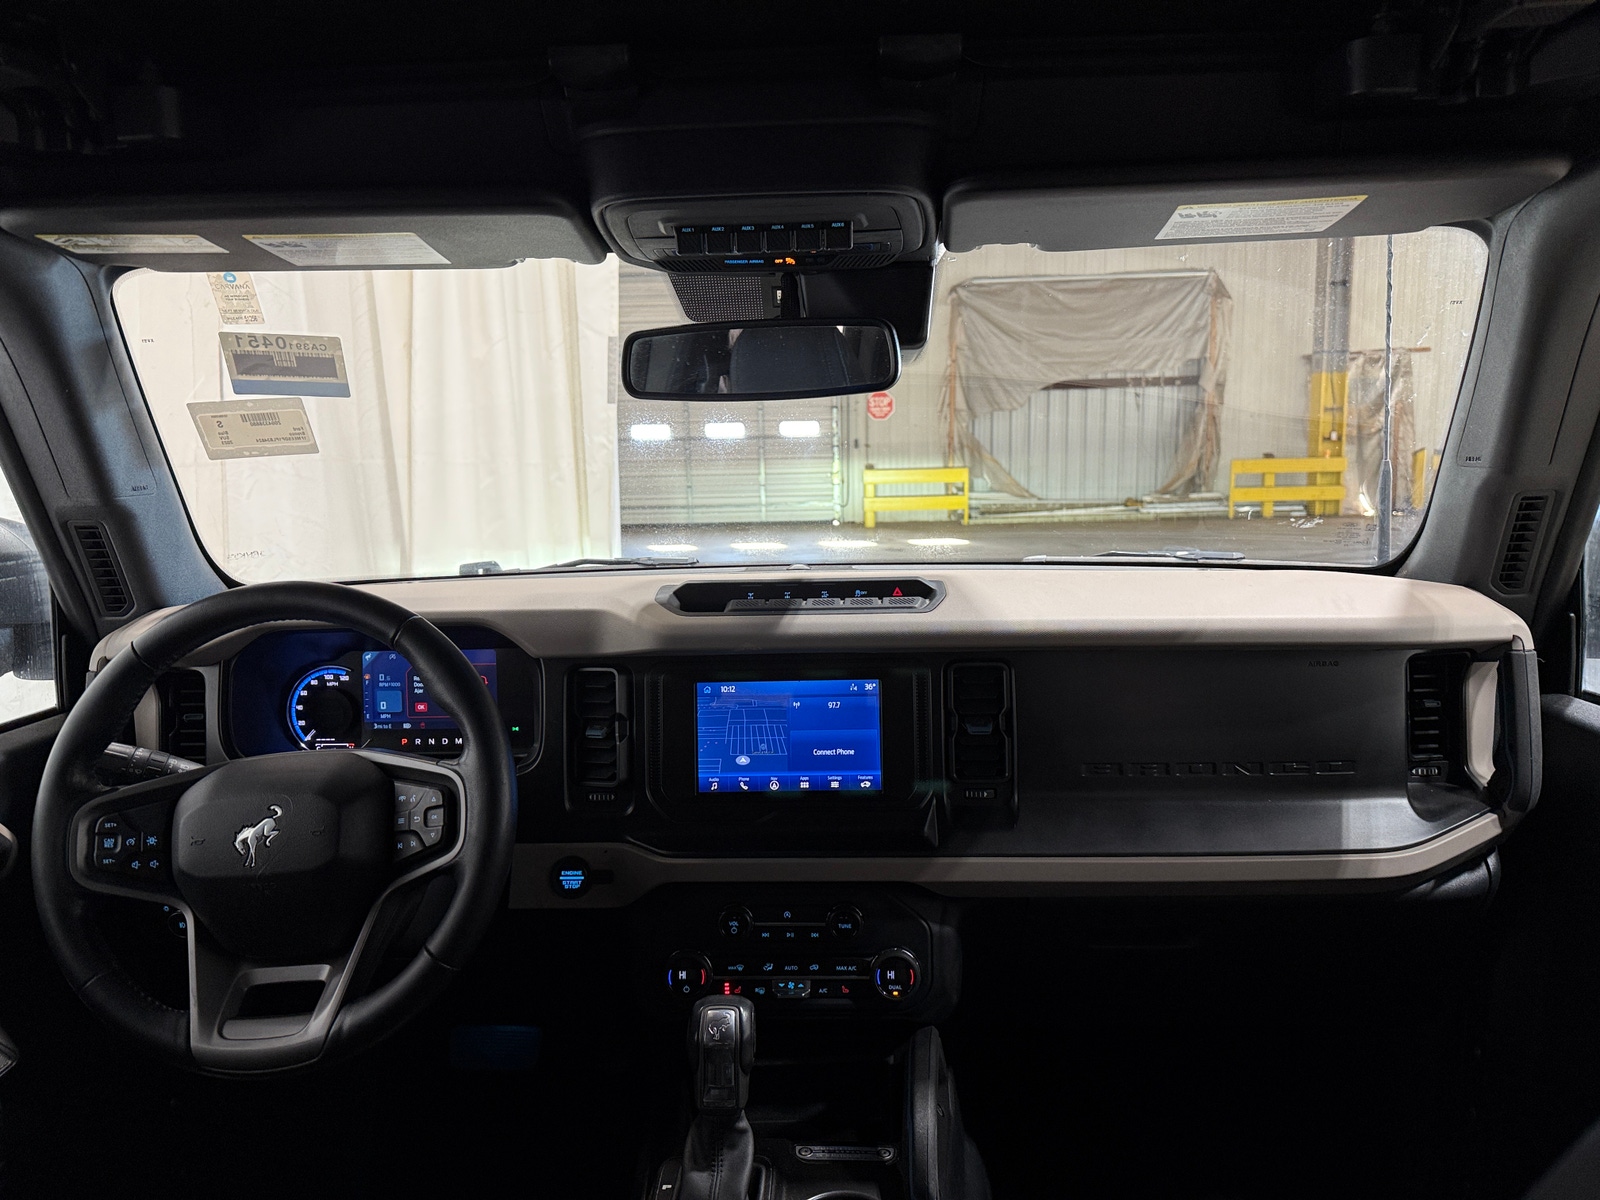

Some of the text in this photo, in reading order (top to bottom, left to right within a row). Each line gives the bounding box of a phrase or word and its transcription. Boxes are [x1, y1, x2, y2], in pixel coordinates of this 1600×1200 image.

[869, 397, 890, 408] STOP
[720, 685, 736, 693] 10:12
[401, 738, 408, 746] P
[428, 737, 435, 745] N
[441, 737, 449, 745] D
[454, 737, 463, 745] M
[1082, 761, 1355, 777] BRONCO
[678, 971, 687, 980] HI
[887, 970, 895, 980] HI
